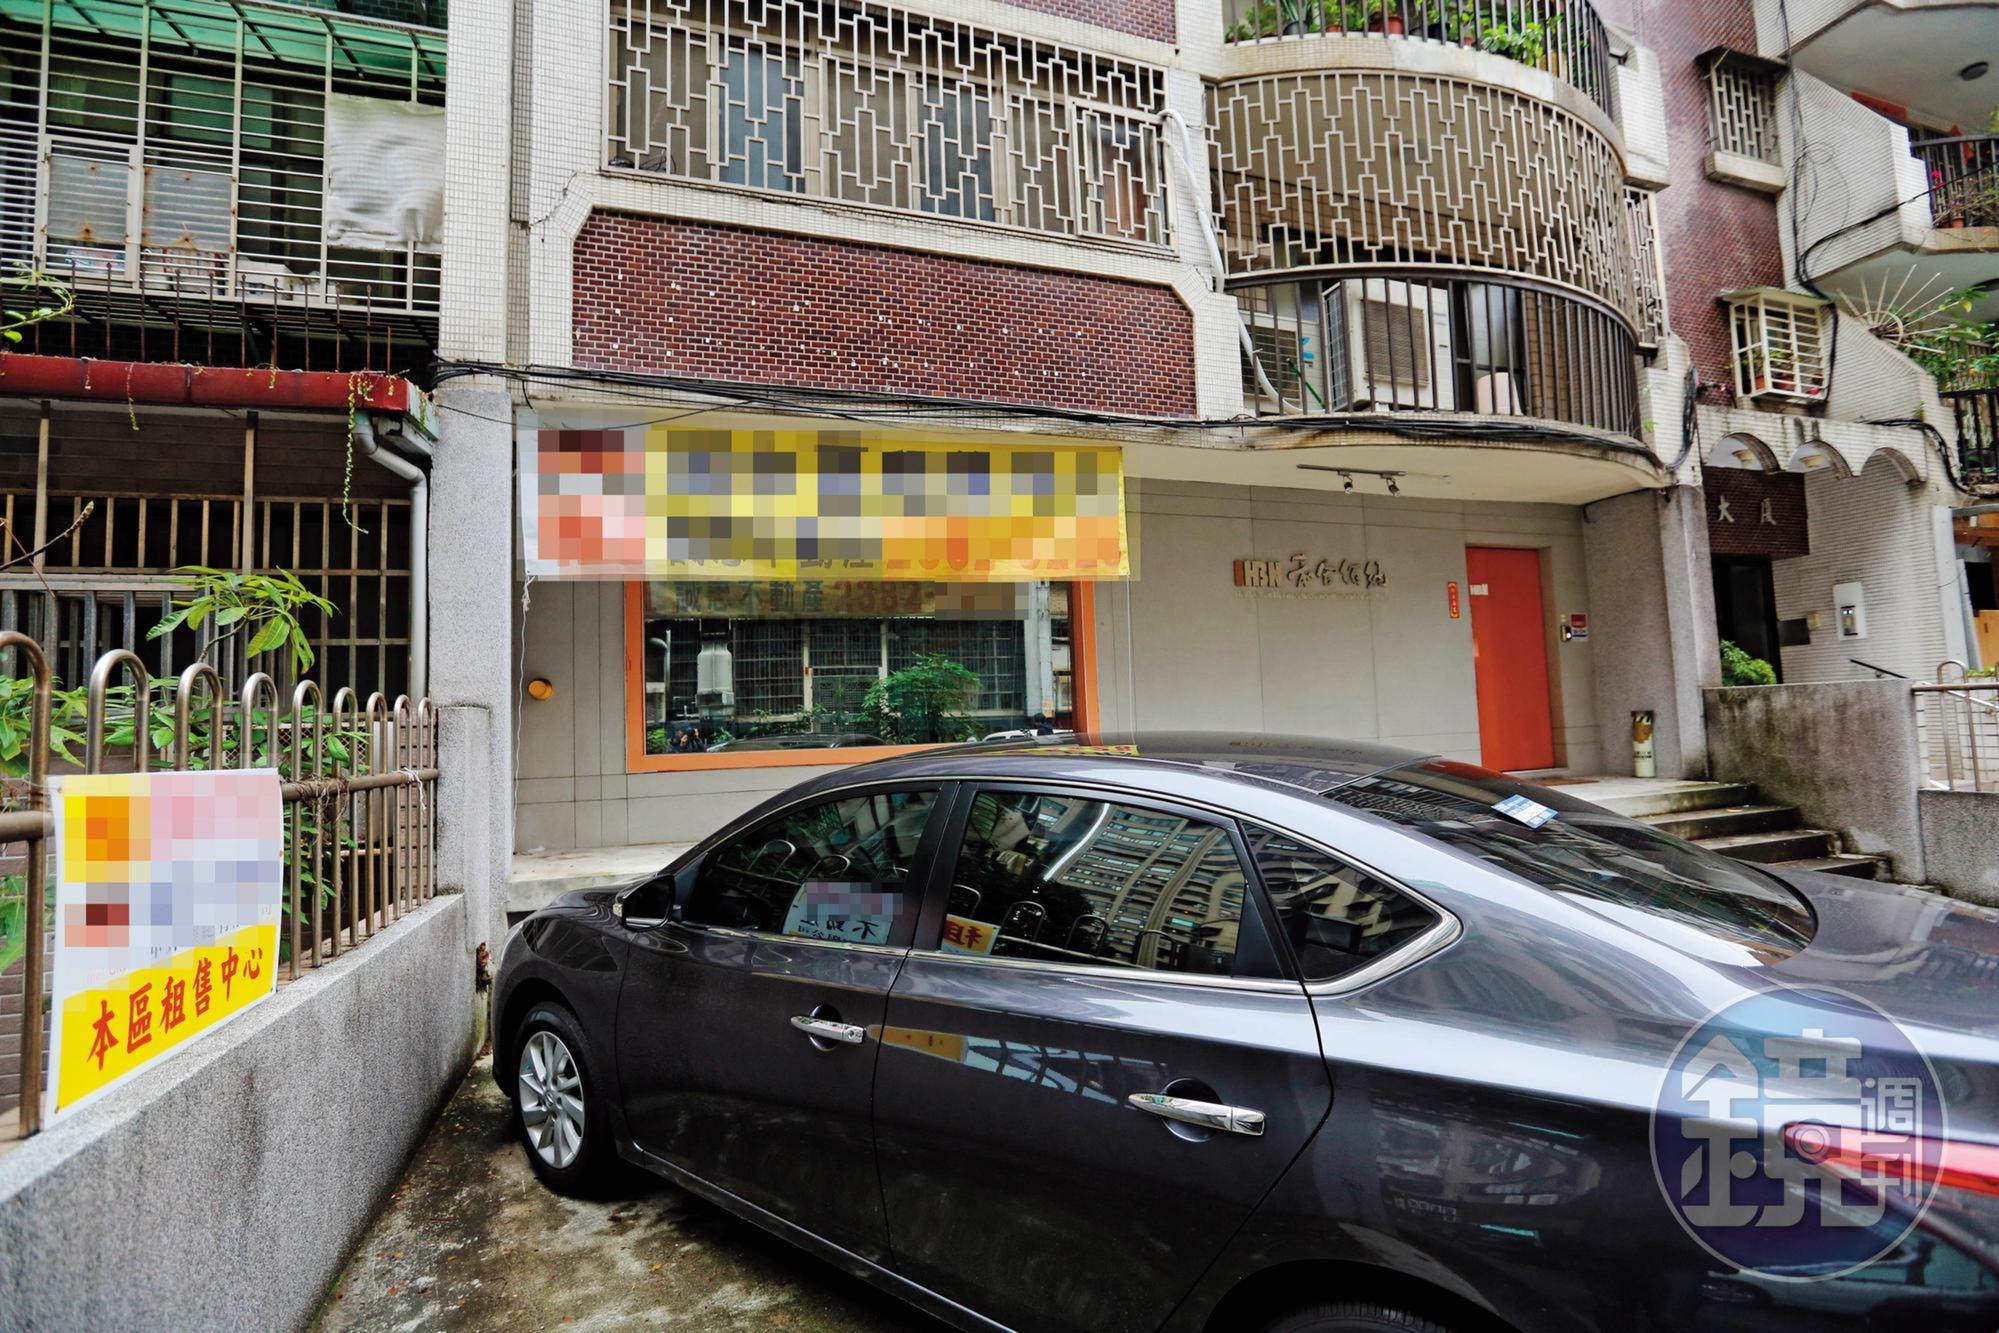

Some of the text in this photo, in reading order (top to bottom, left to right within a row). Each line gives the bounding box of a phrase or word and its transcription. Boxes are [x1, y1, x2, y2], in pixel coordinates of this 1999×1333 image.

[87, 947, 263, 1071] 本區租售中心
